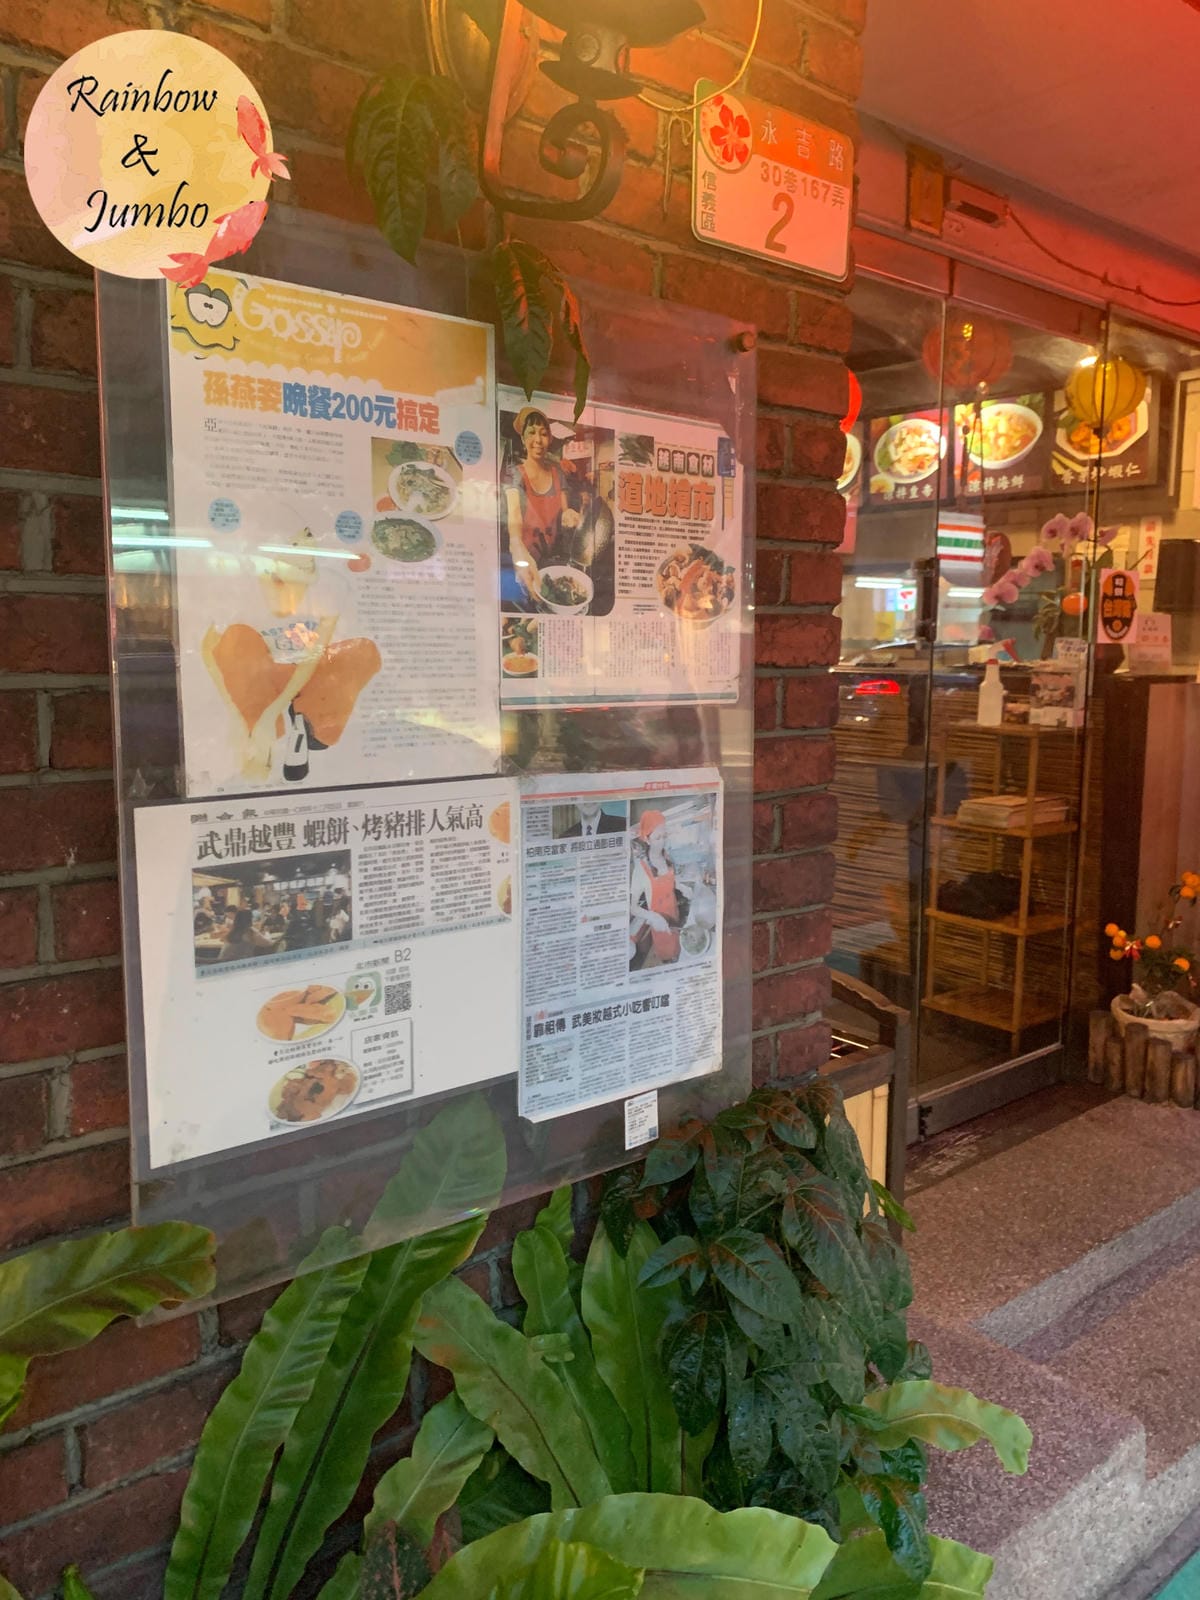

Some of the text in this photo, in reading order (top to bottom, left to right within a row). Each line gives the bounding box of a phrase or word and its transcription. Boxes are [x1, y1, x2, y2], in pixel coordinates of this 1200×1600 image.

[760, 114, 844, 171] 永吉路
[701, 170, 716, 232] 信義區
[760, 161, 845, 209] 30巷167弄
[765, 192, 795, 254] 2
[233, 283, 362, 364] Gossip
[197, 822, 296, 860] 武鼎越豐
[303, 803, 483, 848] 蝦餅、烤豬排人氣高
[394, 947, 412, 963] B2
